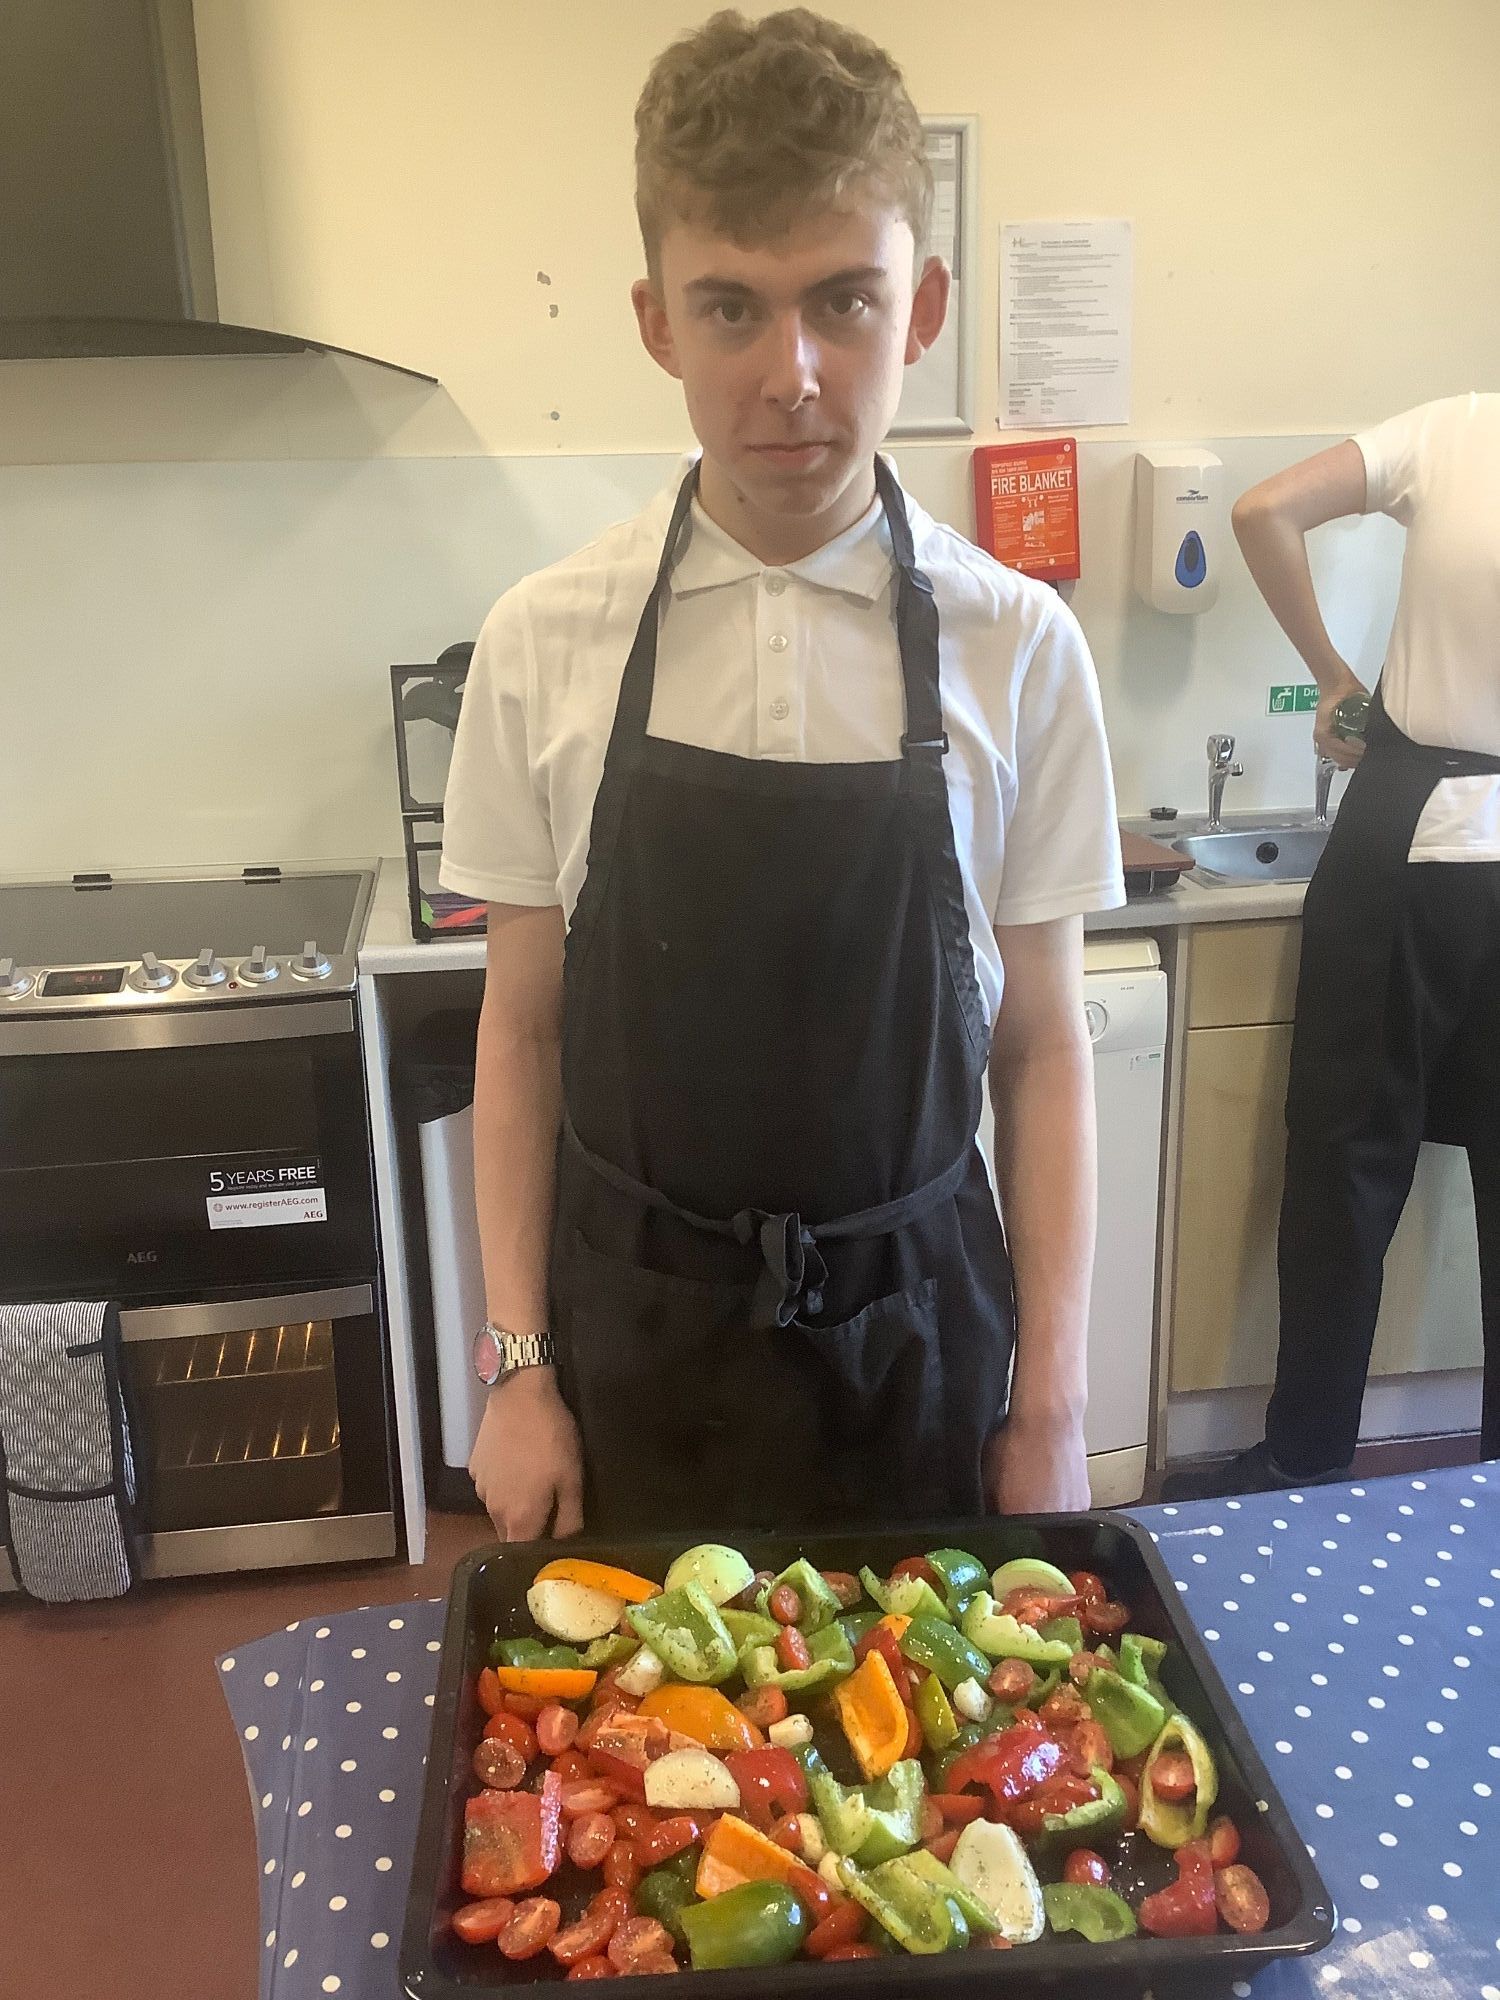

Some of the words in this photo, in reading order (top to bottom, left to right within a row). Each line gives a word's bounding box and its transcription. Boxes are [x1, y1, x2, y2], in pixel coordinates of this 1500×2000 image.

[991, 476, 1017, 496] FIRE
[1019, 469, 1072, 493] BLANKET
[209, 1171, 225, 1192] 5
[226, 1169, 275, 1184] YEARS
[278, 1166, 316, 1180] FREE
[225, 1196, 318, 1211] www.registerAEG.com
[303, 1210, 323, 1219] AEG
[127, 1251, 158, 1263] AEG
